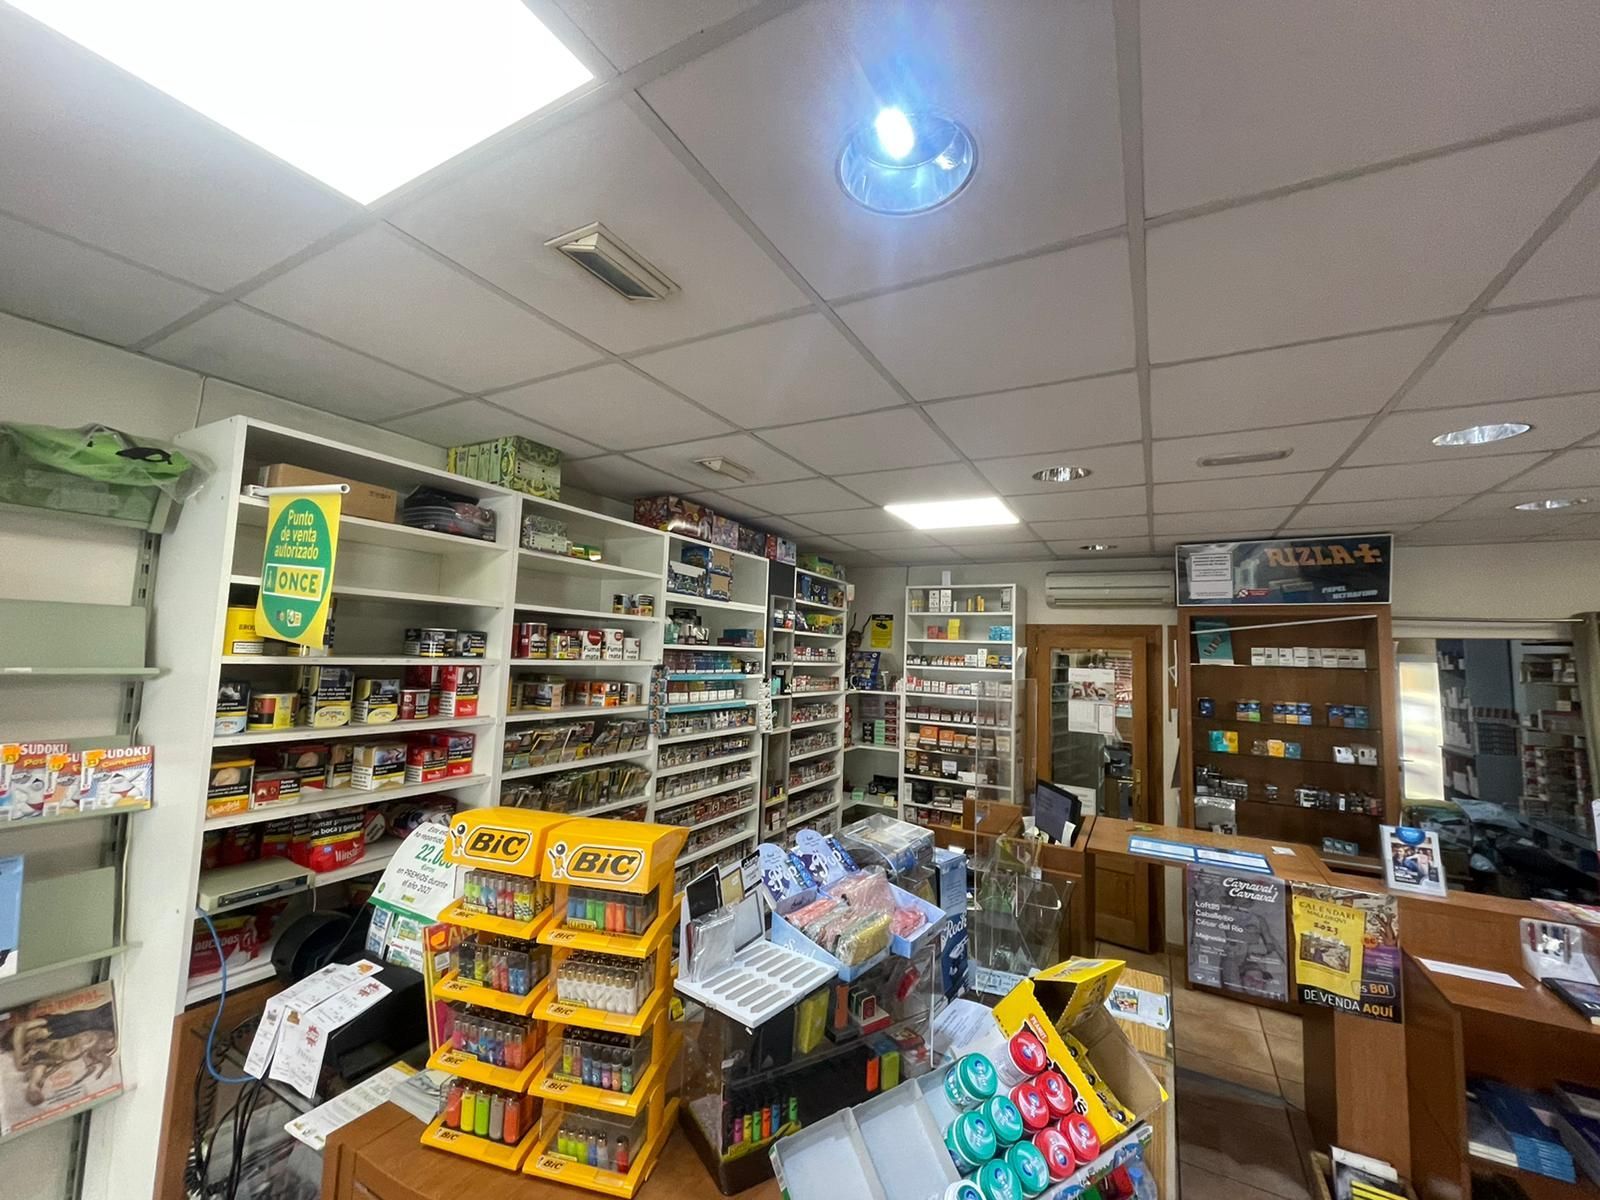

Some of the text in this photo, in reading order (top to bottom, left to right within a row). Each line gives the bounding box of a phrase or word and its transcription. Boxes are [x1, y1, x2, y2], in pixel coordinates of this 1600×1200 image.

[288, 509, 314, 526] Punto
[281, 526, 317, 542] de venta
[274, 543, 319, 560] autorizado
[279, 571, 319, 593] ONCE
[20, 744, 68, 756] SUDOKU
[101, 747, 150, 759] SUDOKU
[320, 827, 338, 835] boca
[404, 868, 429, 883] PREMIOS
[429, 877, 448, 889] durante
[417, 884, 432, 895] 2021
[1228, 887, 1279, 903] Carnaval
[1304, 988, 1316, 1000] DE
[1319, 991, 1361, 1011] VENDA
[1029, 1015, 1047, 1040] PEANUT
